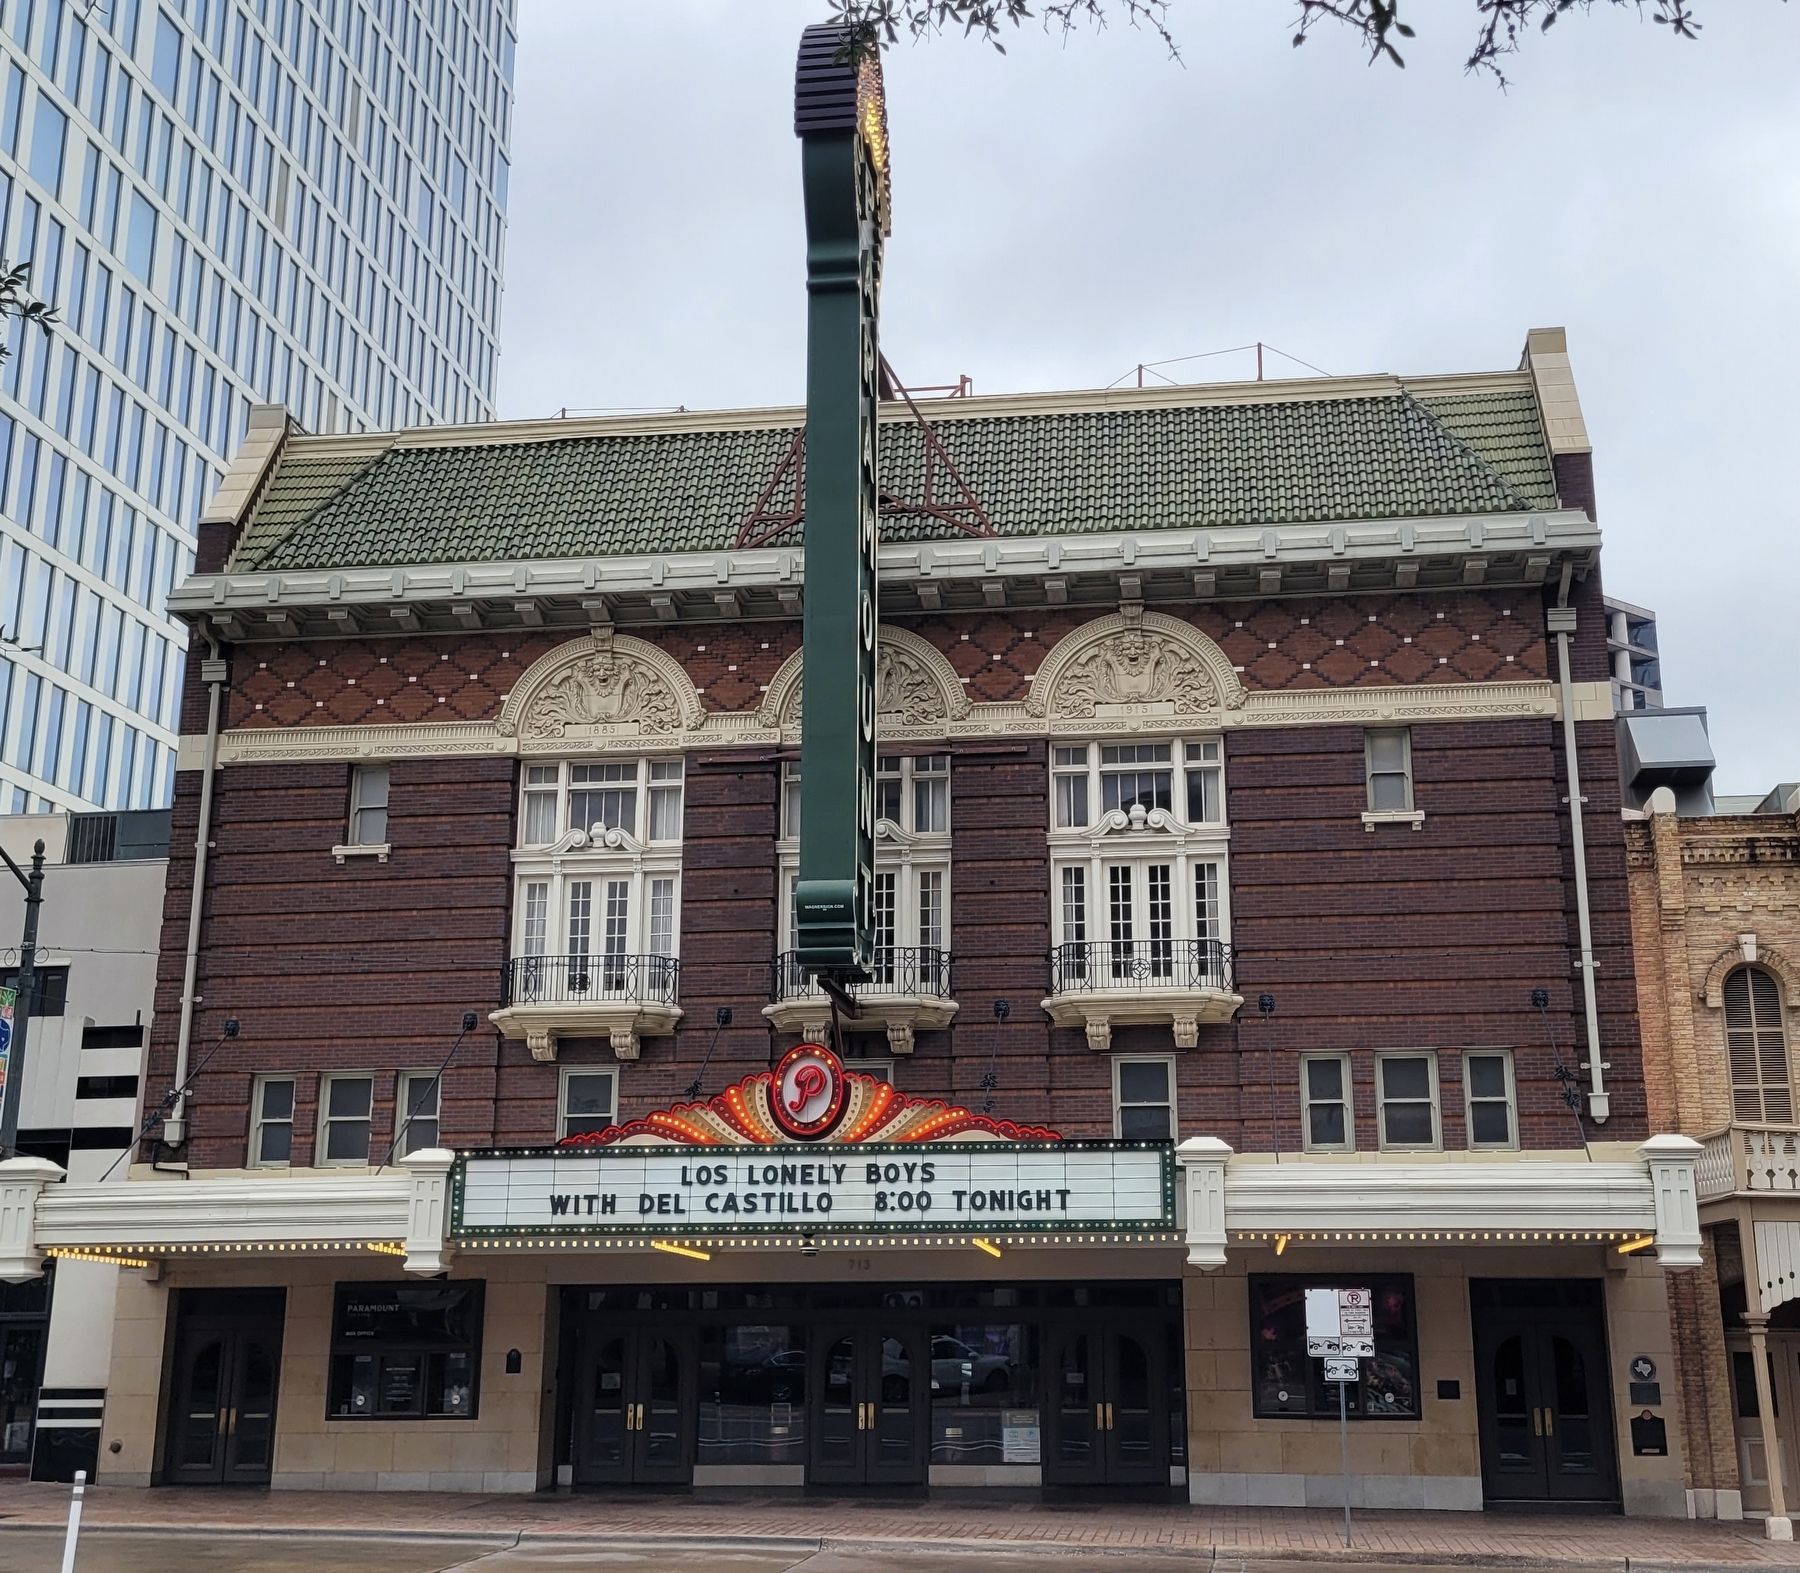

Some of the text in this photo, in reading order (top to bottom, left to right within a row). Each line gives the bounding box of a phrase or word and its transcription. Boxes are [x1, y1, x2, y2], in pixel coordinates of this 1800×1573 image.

[1119, 705, 1149, 715] 1915
[588, 725, 616, 735] 1885
[788, 1064, 828, 1113] P
[681, 1161, 936, 1186] LOS LONELY BOYS
[549, 1188, 1071, 1216] WITH DEL CASTILLO 8:00 TONIGHT
[848, 1258, 871, 1271] 713
[347, 1304, 400, 1313] PARAMOUNT
